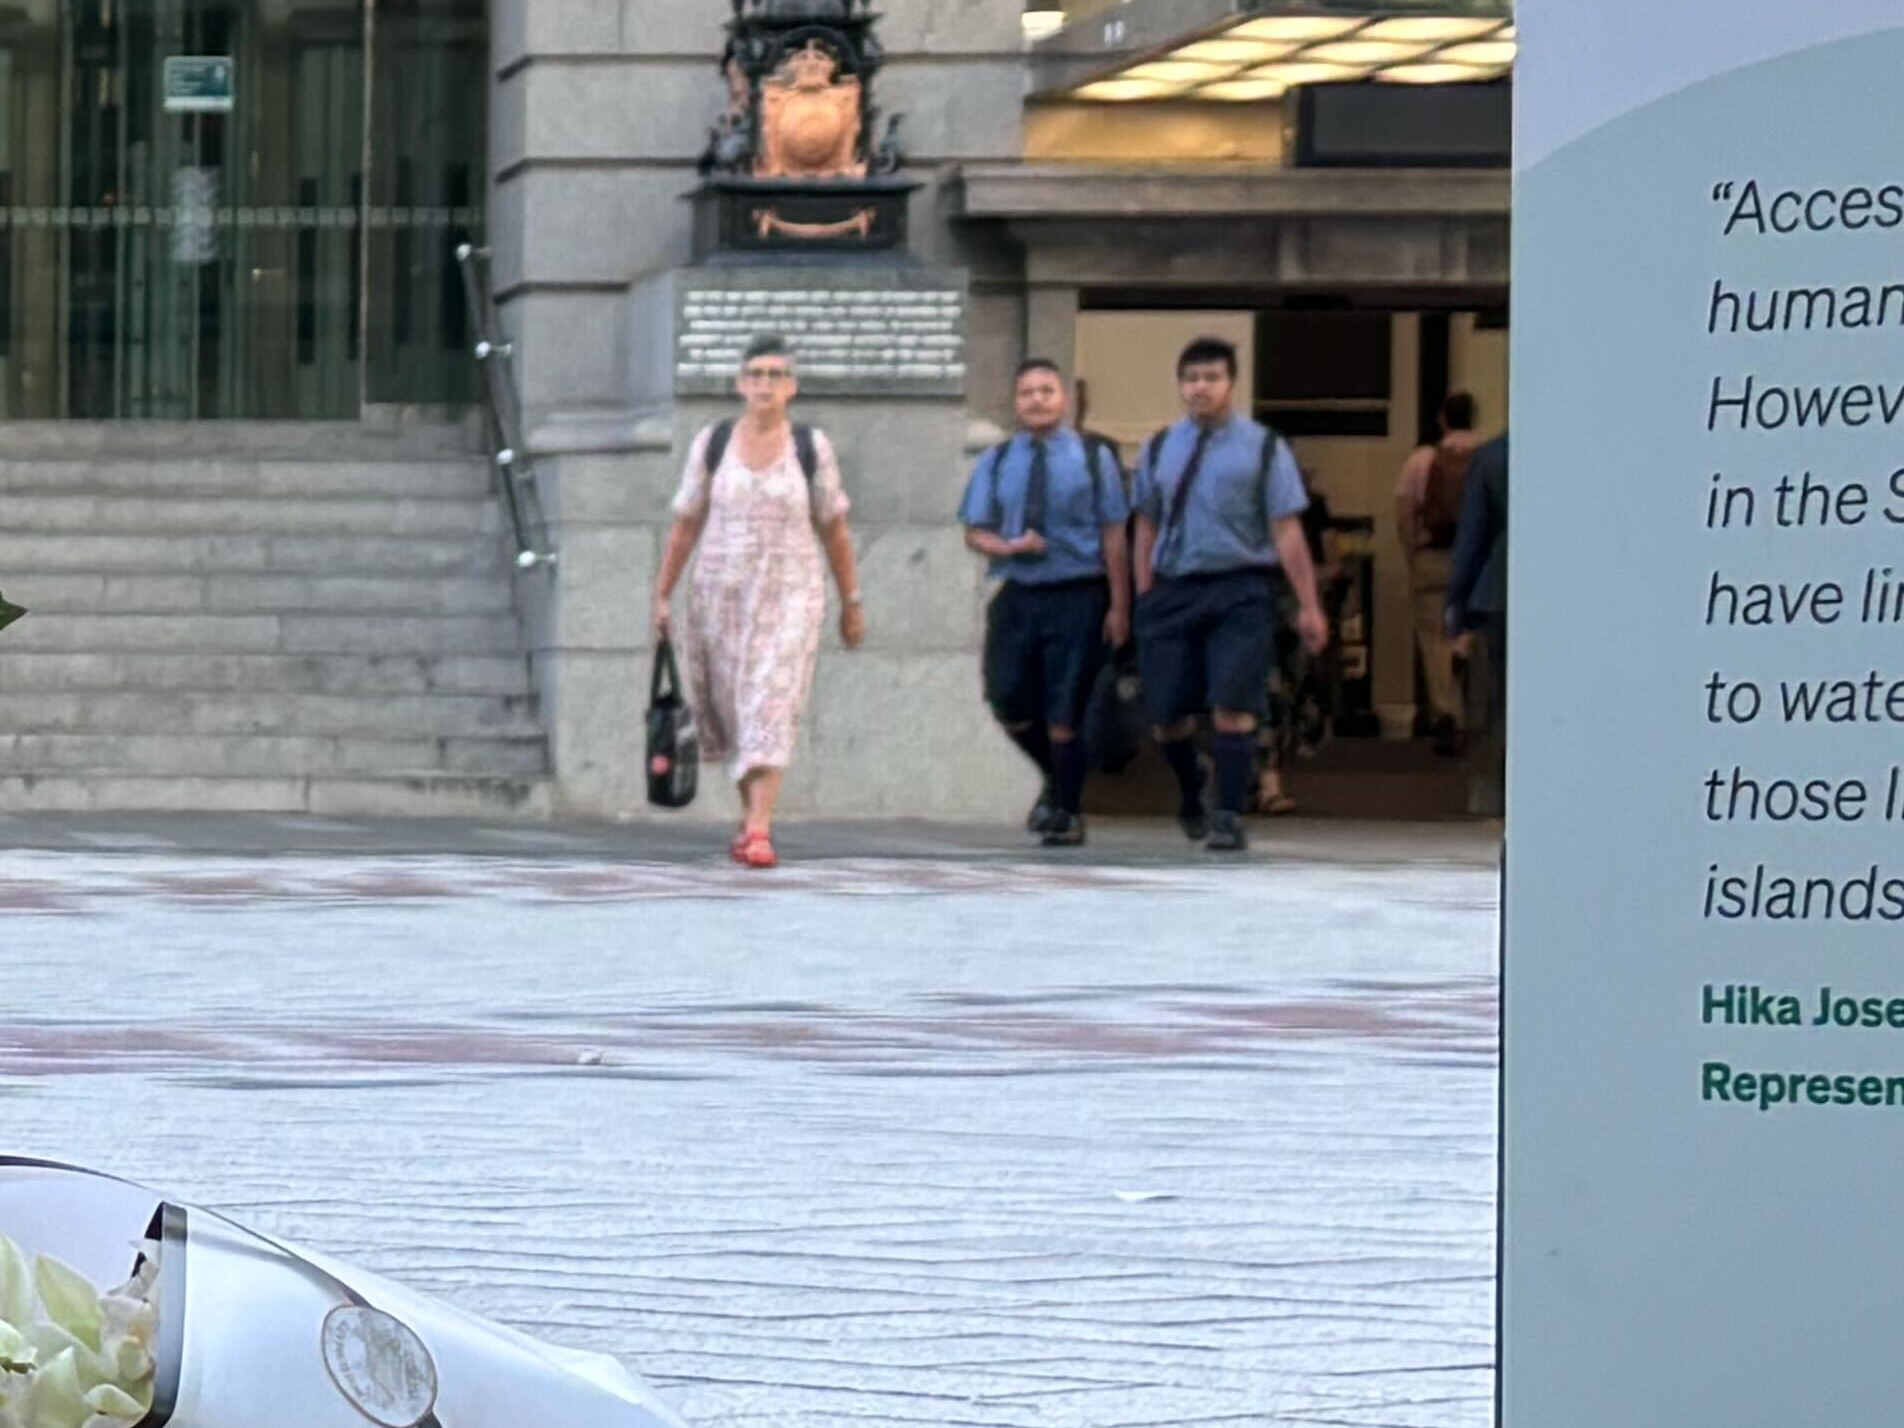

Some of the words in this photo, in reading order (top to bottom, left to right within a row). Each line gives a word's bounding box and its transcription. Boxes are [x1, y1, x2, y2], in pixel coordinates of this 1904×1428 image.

[1707, 473, 1755, 529] in
[1774, 471, 1869, 528] the
[1705, 571, 1844, 626] have
[1860, 566, 1904, 625] li
[1705, 671, 1762, 724] to
[1704, 766, 1868, 822] those
[1701, 982, 1804, 1026] Hika
